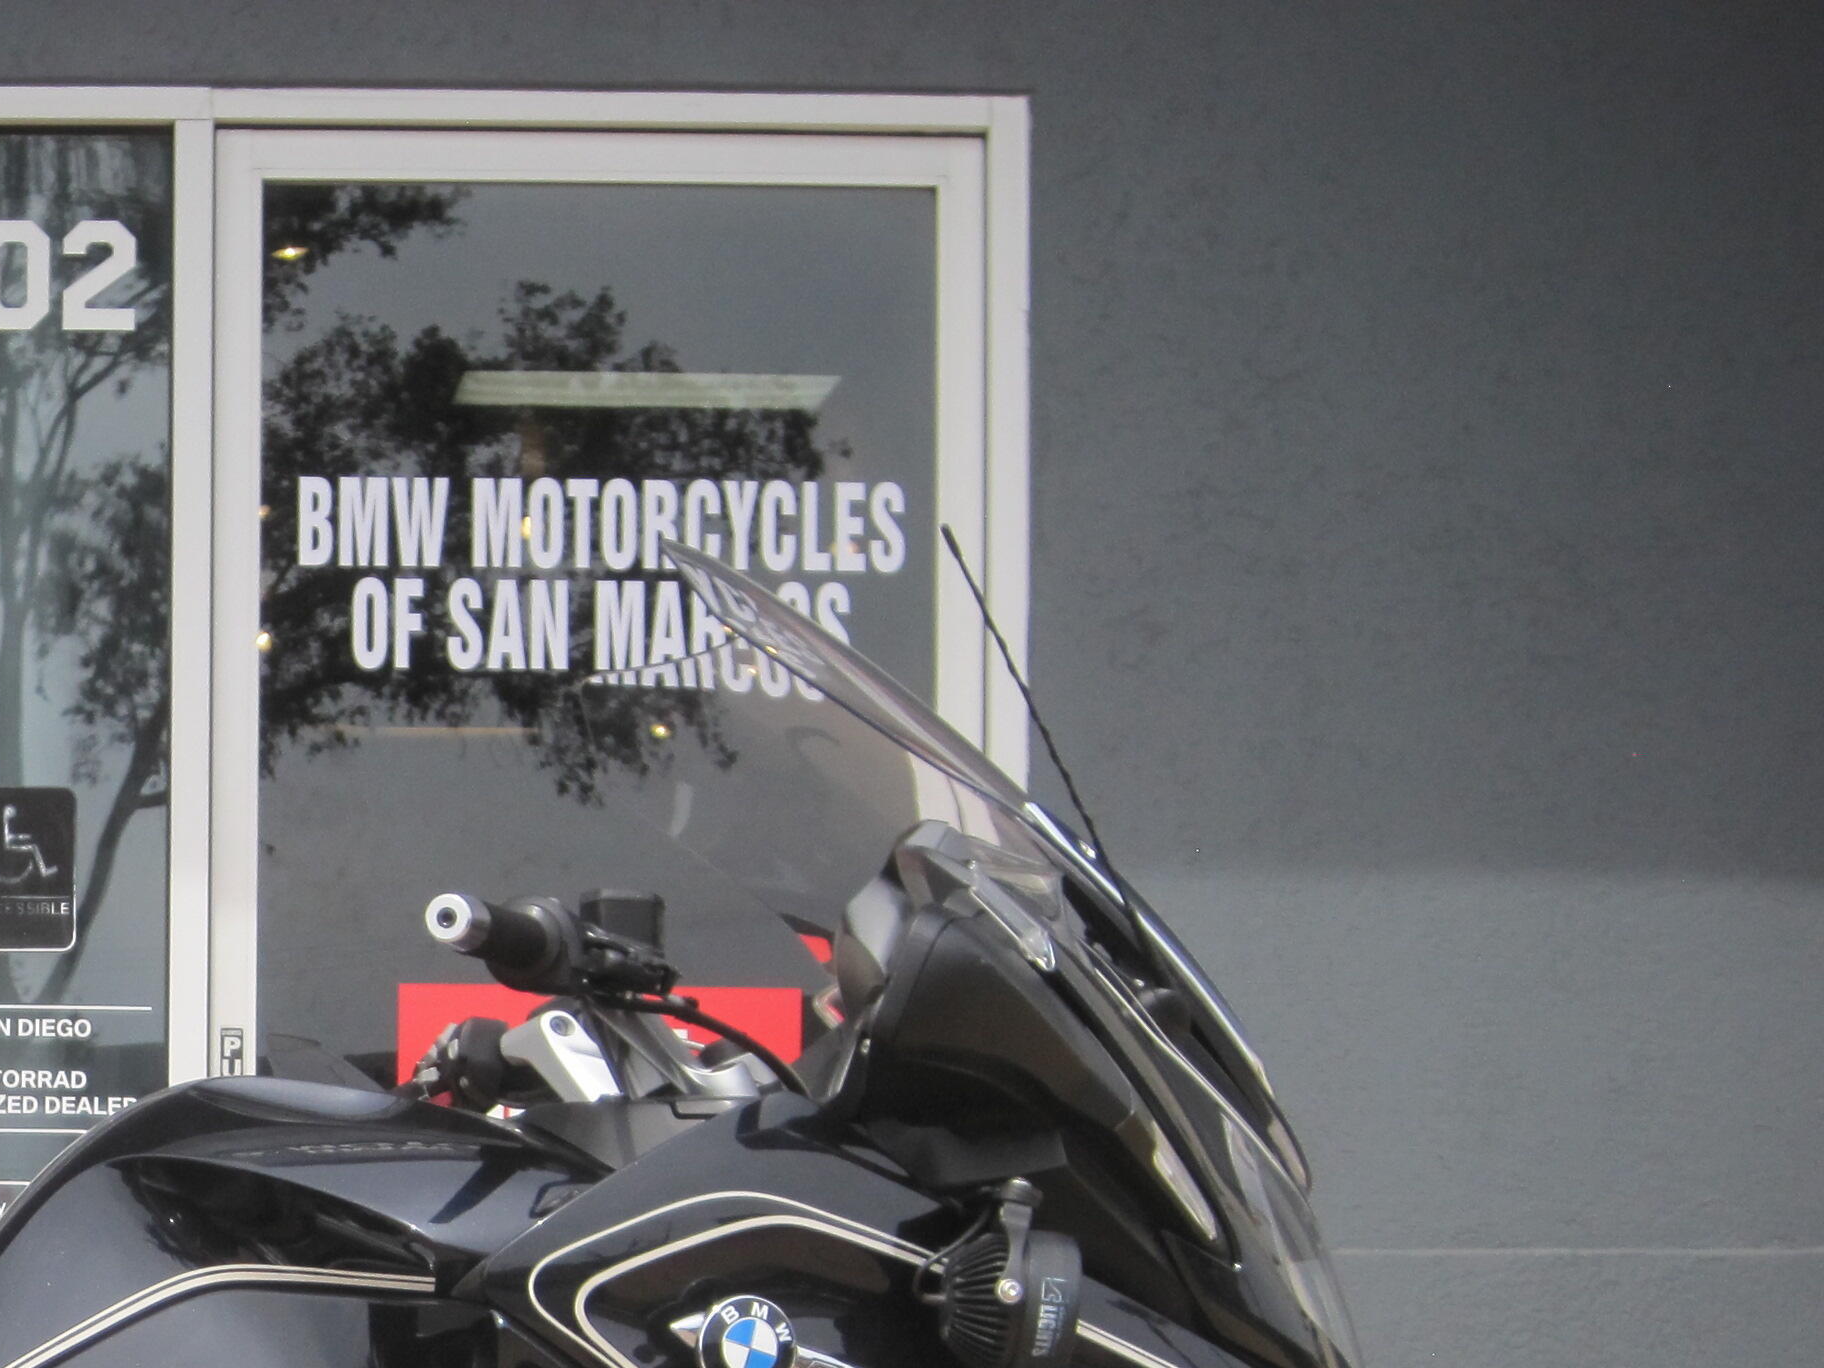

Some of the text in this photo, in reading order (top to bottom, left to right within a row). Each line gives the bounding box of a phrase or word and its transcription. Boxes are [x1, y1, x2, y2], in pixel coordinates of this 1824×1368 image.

[297, 475, 906, 574] BMW MOTORCYCLES
[351, 577, 425, 671] OF
[446, 577, 570, 672] SAN
[18, 1018, 92, 1039] DIEGO
[222, 1036, 242, 1077] PU
[720, 1301, 793, 1342] BMW
